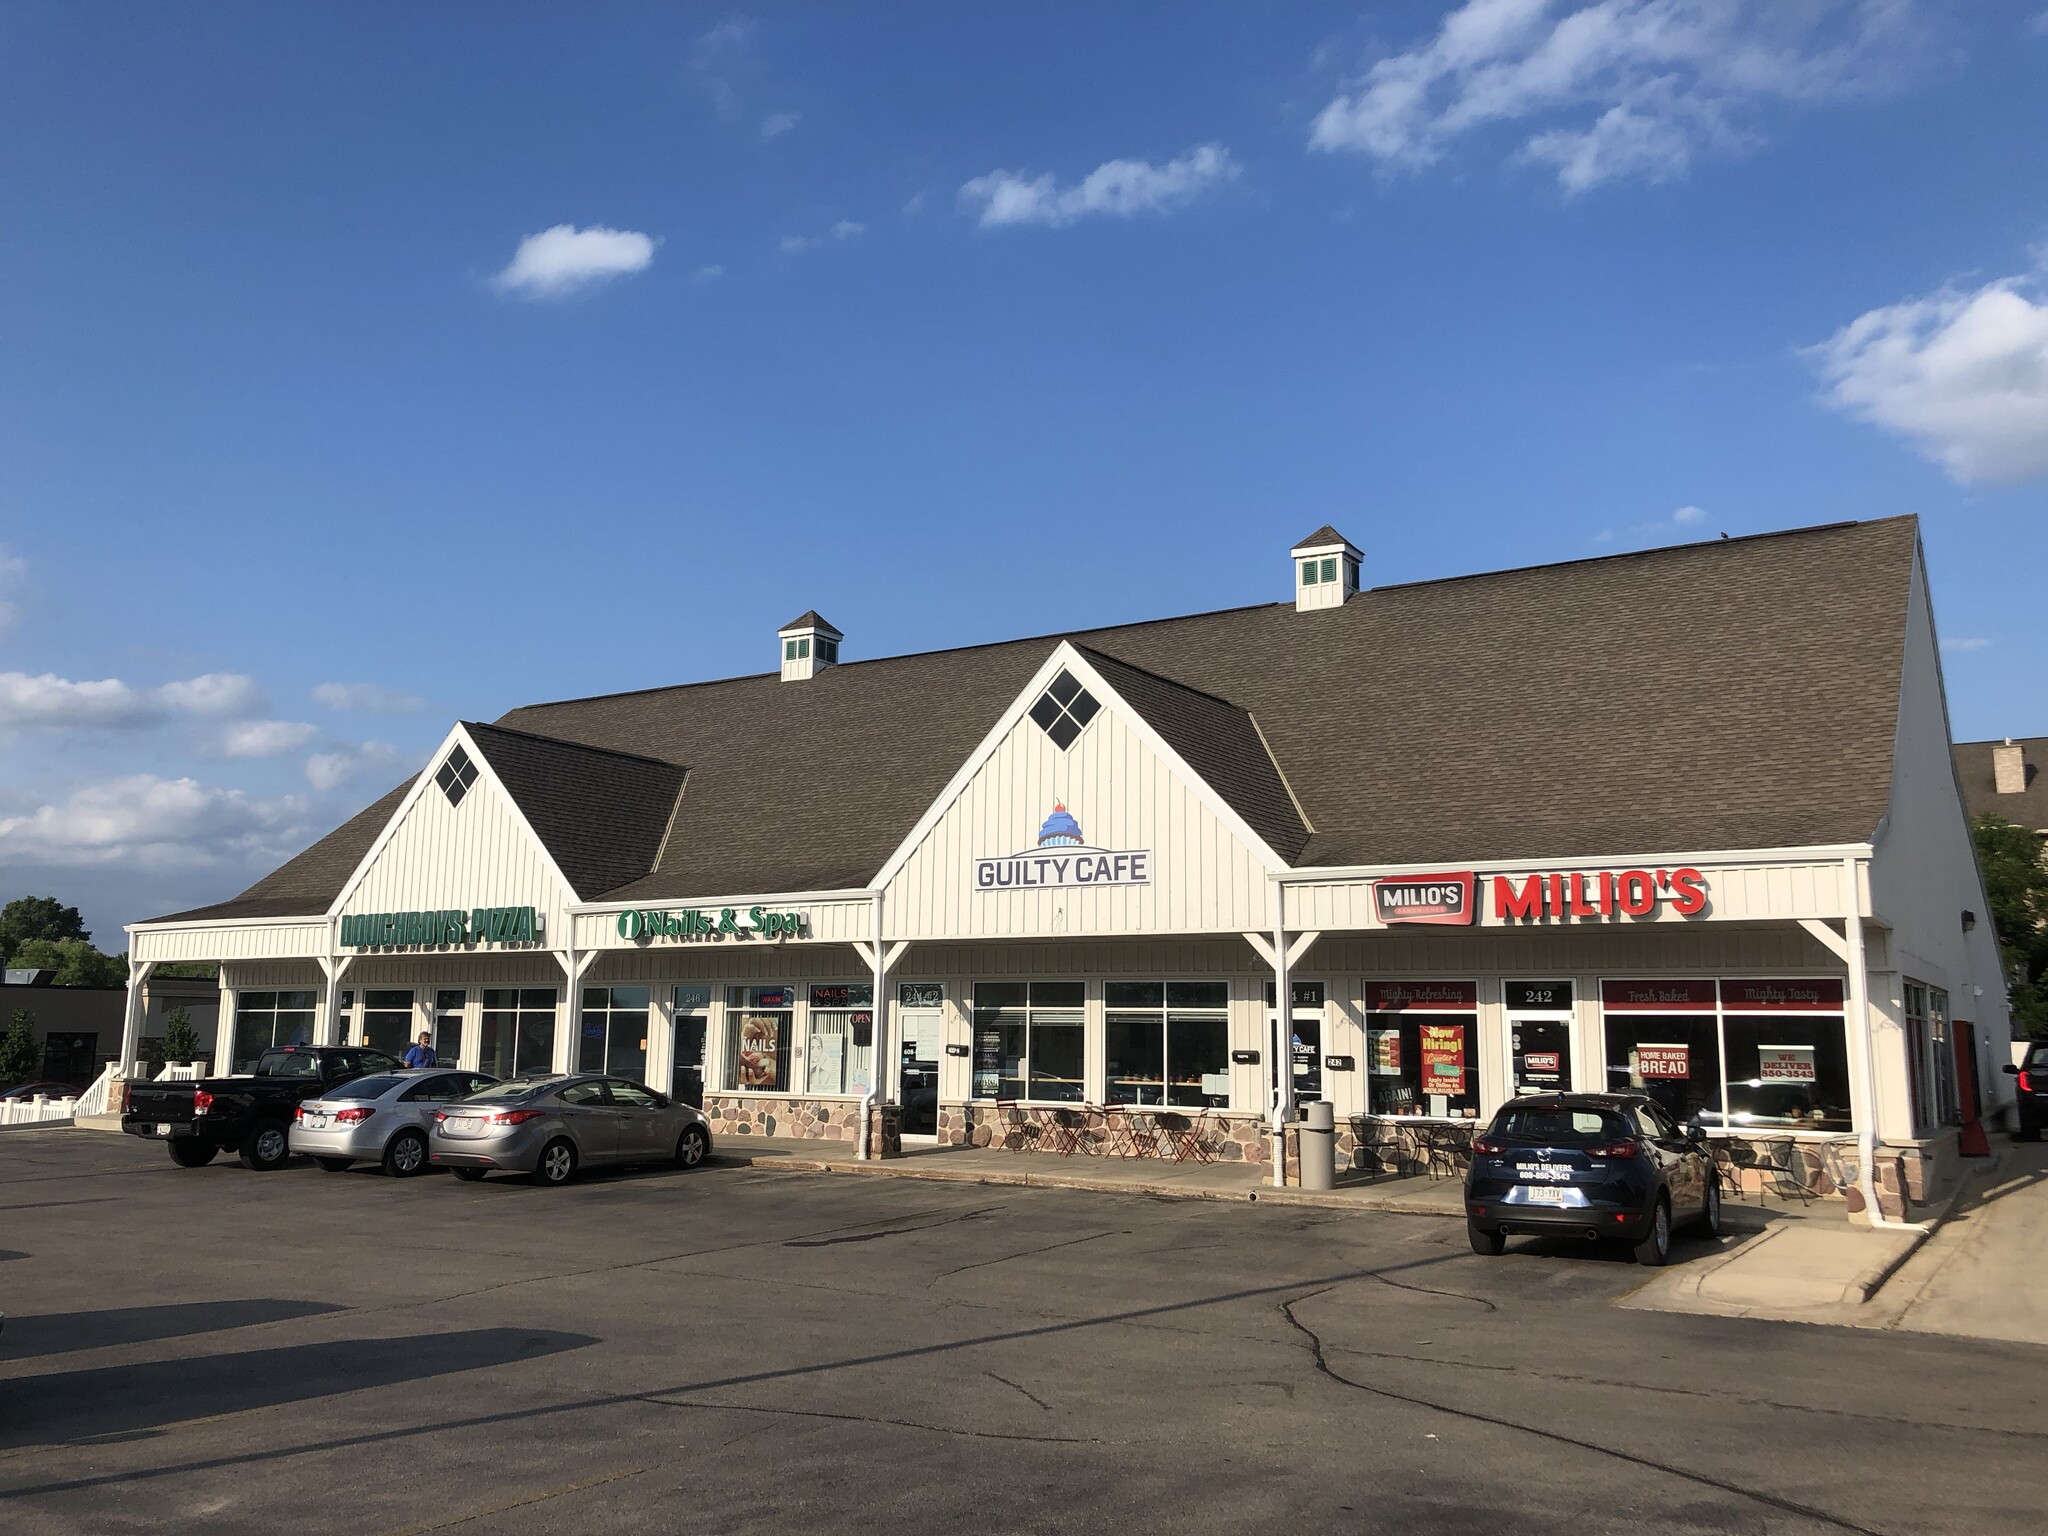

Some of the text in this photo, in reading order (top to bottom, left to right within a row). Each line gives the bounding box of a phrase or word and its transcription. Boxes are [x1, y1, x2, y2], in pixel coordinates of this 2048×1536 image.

[978, 855, 1147, 887] GUILTY CAFE
[1383, 886, 1459, 907] MILIO'S
[1494, 868, 1706, 918] MILIO'S
[340, 906, 536, 948] DOUGHBOYS PIZZA
[646, 908, 714, 937] Nails
[718, 907, 741, 934] &
[749, 906, 800, 938] Spa
[685, 993, 702, 1003] 246
[815, 988, 848, 999] NAILS
[1303, 990, 1317, 1002] #1
[1379, 986, 1463, 1004] Mighty Refreshing
[1525, 990, 1552, 1003] 242
[1627, 988, 1690, 1002] Fresh Baked
[1744, 986, 1820, 1005] Mighty Tasty
[852, 1013, 871, 1024] OPEN
[1429, 1026, 1455, 1039] Now
[742, 1038, 776, 1053] NAILS
[1422, 1038, 1463, 1053] Hiring!
[1327, 1058, 1342, 1066] 242
[1527, 1057, 1554, 1065] MILIO'S
[1640, 1051, 1686, 1061] HOME BAKED
[1777, 1053, 1796, 1062] WE
[1641, 1060, 1687, 1075] BREAD
[1763, 1062, 1812, 1070] DELIVER
[1761, 1070, 1815, 1078] 850-3543
[1378, 1087, 1413, 1102] AGAIN!
